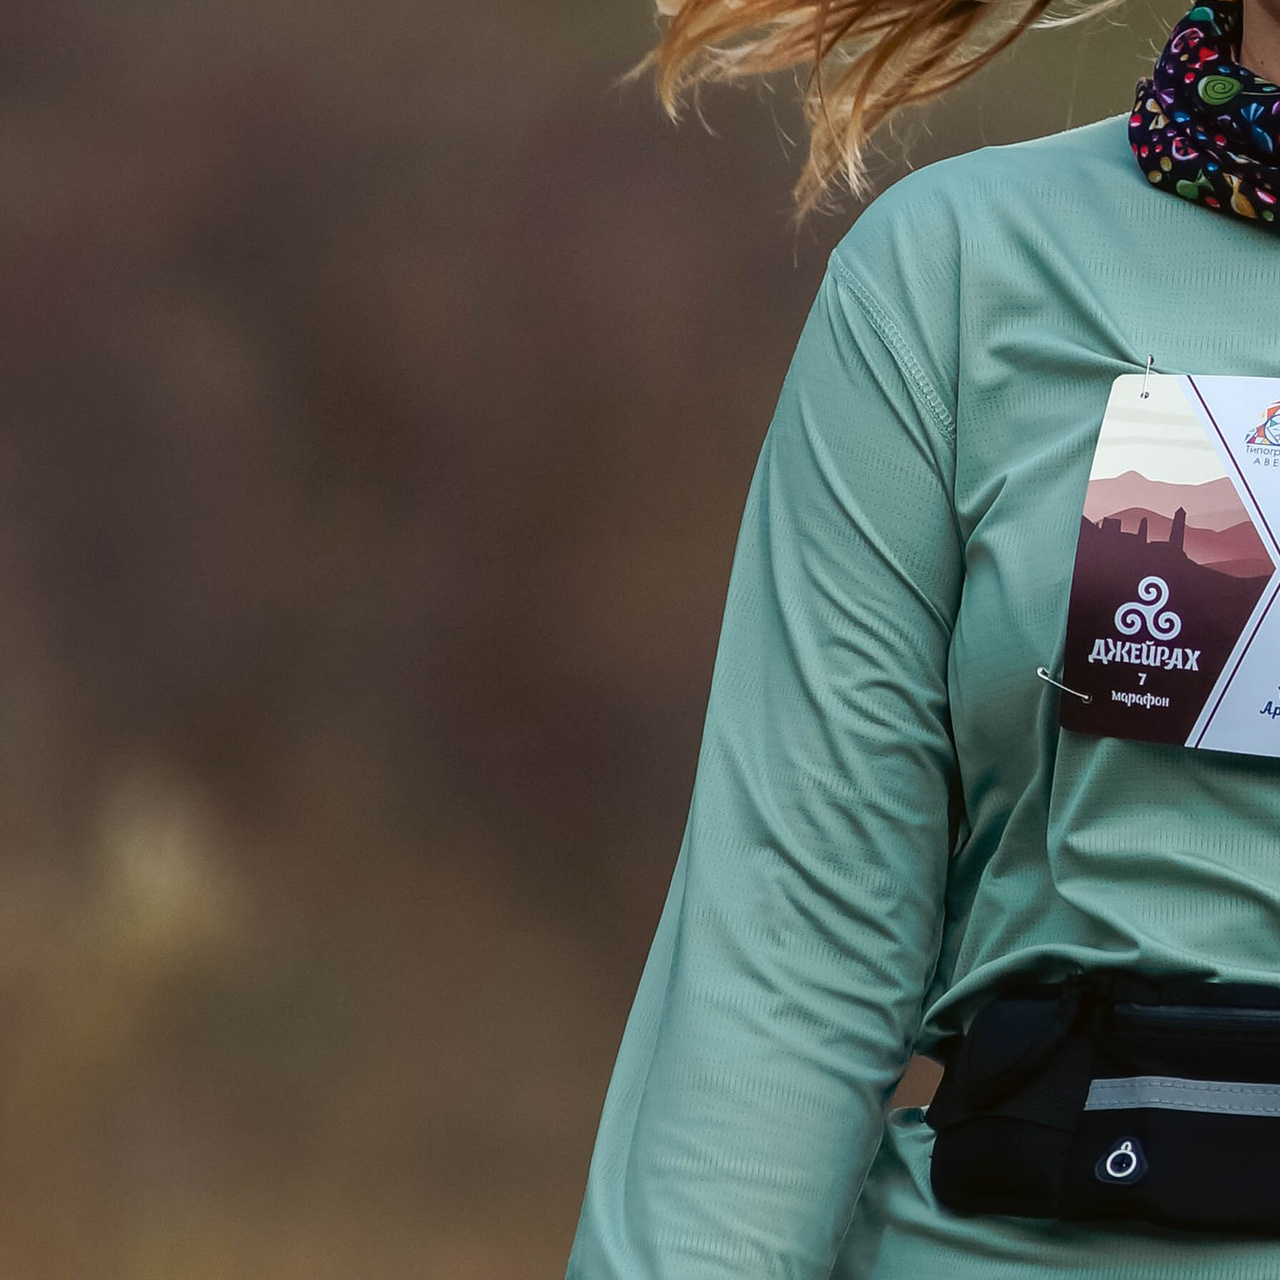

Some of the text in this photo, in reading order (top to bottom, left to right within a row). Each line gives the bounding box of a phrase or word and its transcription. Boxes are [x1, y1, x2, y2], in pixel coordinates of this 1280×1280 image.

[1088, 638, 1201, 671] ДЖЕЙРАХ
[1138, 672, 1147, 686] 7
[1111, 690, 1170, 709] марафон
